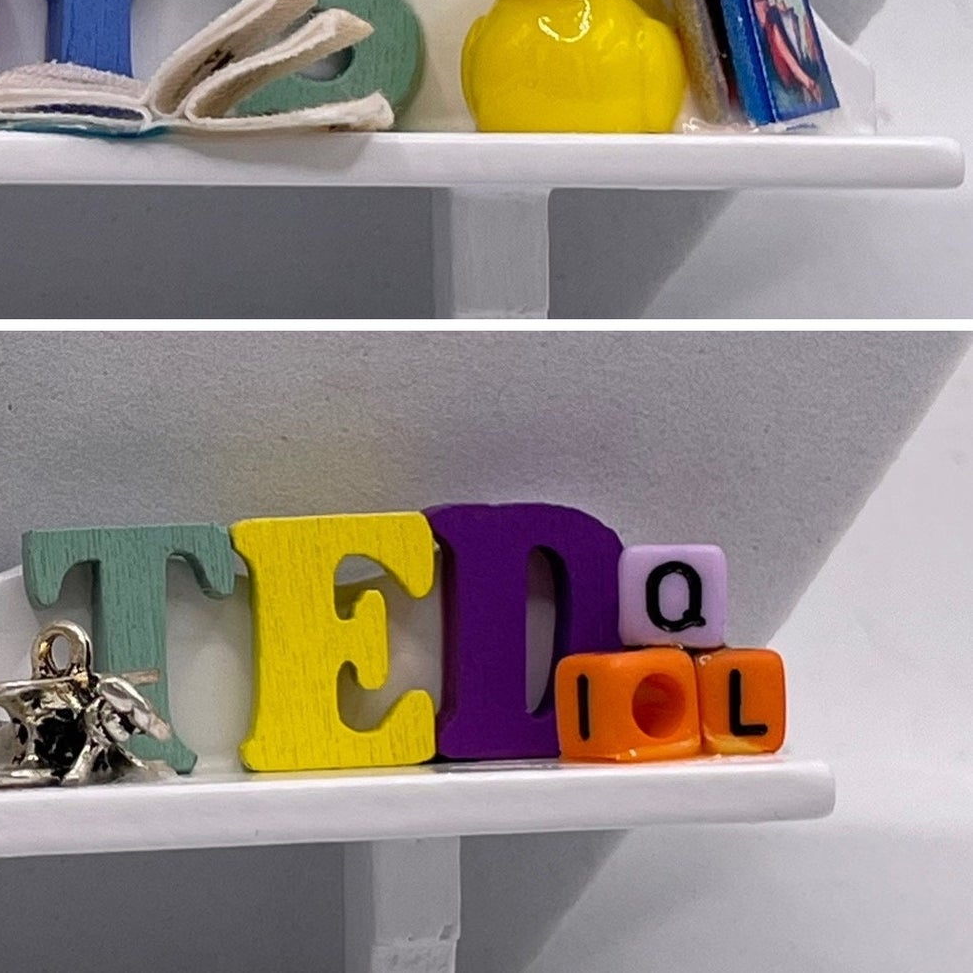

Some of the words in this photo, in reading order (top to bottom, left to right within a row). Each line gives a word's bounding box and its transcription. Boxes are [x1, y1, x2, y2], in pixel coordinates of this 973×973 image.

[645, 560, 707, 631] Q
[21, 502, 625, 776] TED
[576, 672, 591, 742] I
[729, 667, 768, 736] L
